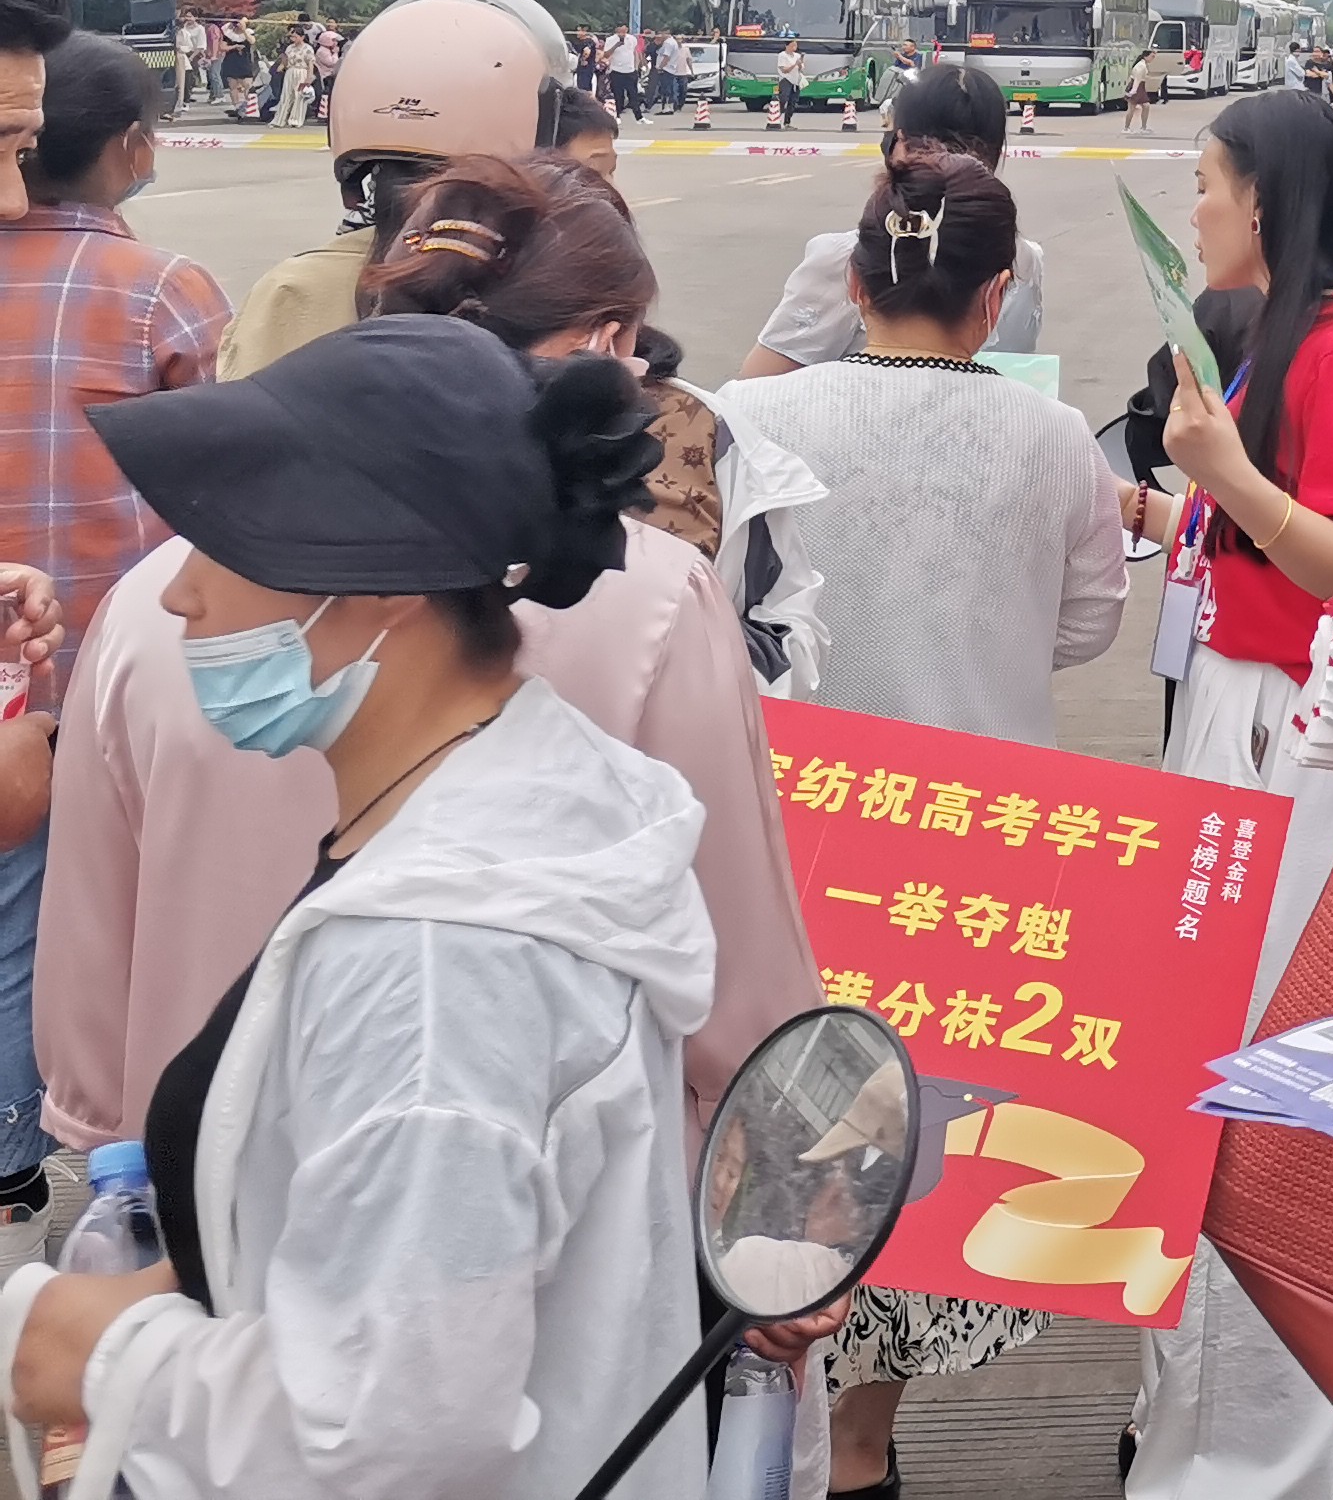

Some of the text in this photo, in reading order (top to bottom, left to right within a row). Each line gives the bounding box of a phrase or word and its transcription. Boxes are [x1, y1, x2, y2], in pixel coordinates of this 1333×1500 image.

[1220, 818, 1258, 904] 喜登金科
[824, 880, 1073, 961] 一举夺魁
[819, 968, 1123, 1071] 满分袜2双
